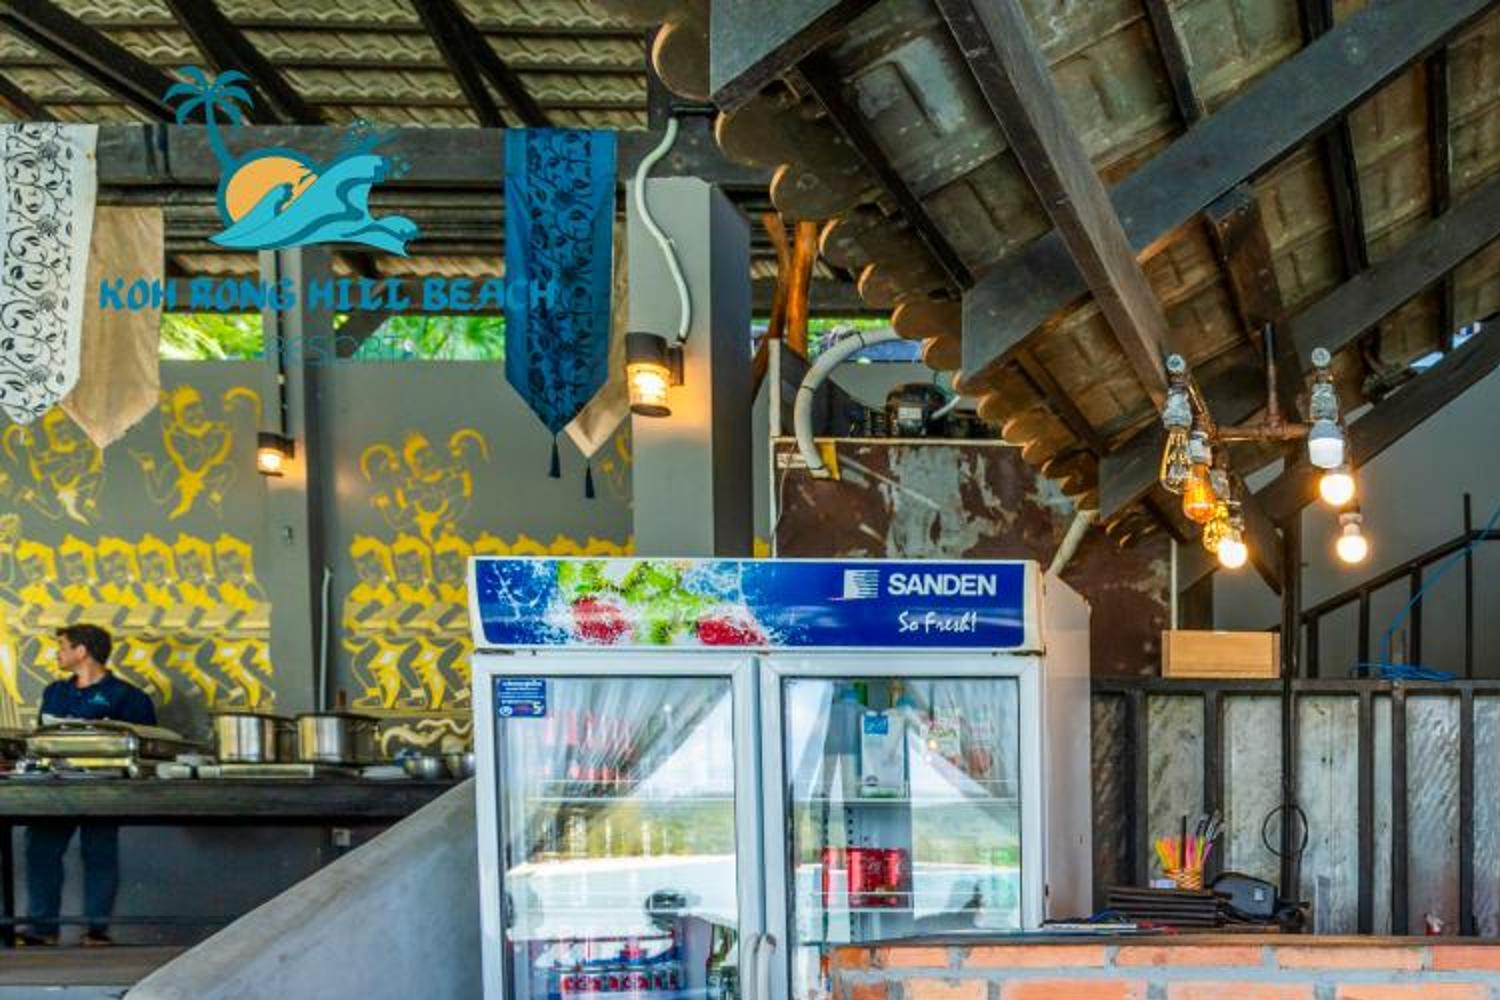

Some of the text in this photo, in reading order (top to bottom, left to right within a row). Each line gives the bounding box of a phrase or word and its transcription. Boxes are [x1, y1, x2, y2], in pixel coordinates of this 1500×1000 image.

[887, 573, 998, 597] SANDEN
[898, 610, 978, 633] So Fresh!
